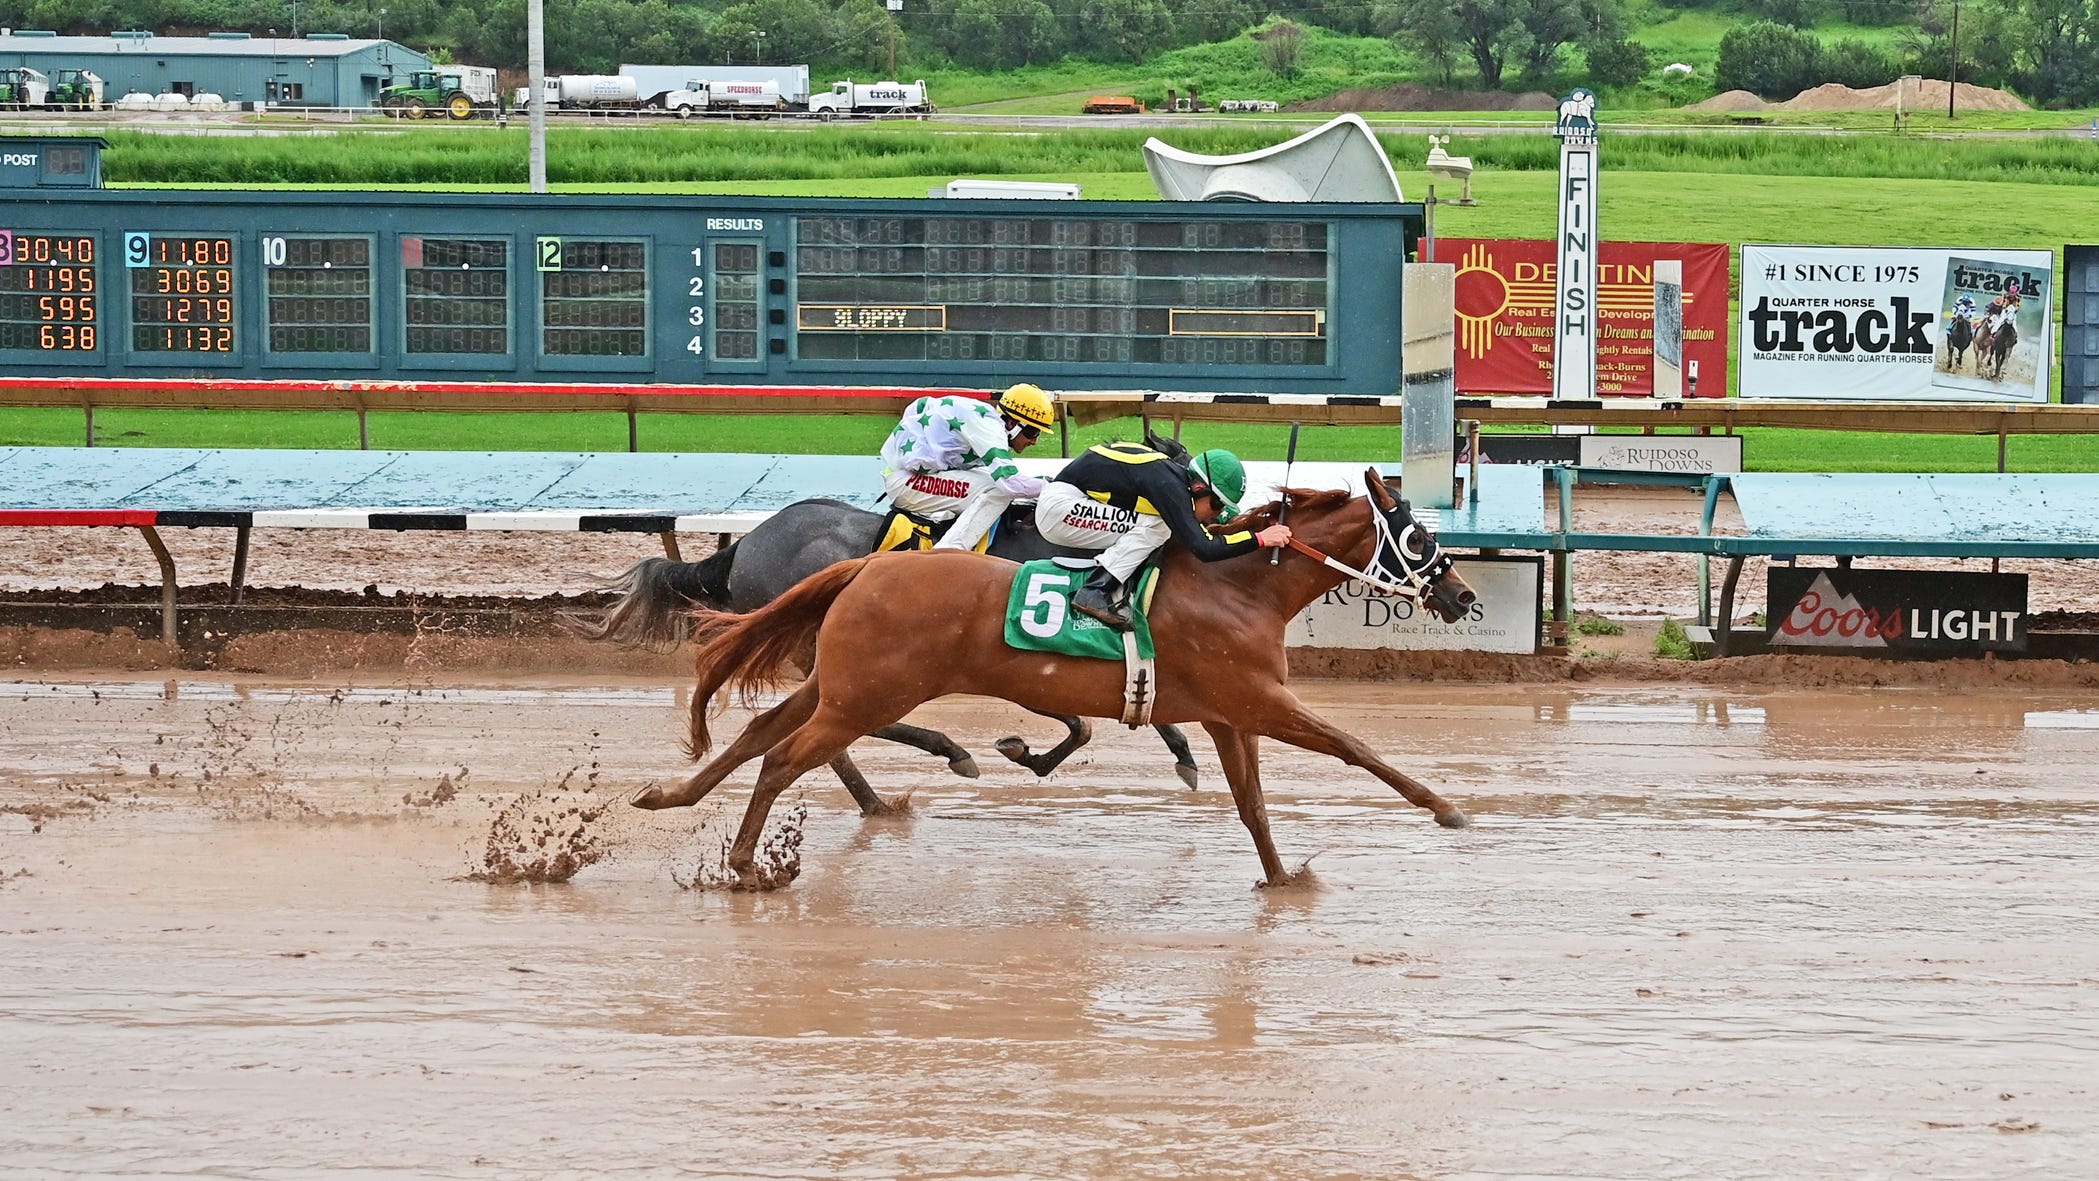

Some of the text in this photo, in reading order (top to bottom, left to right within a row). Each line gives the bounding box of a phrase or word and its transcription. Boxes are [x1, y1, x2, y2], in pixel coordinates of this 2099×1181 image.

[869, 89, 908, 100] track
[1552, 126, 1592, 136] RUIDOSO
[1564, 136, 1598, 145] DOWNS
[4, 154, 38, 166] POST
[706, 218, 764, 231] RESULTS
[128, 235, 148, 264] 9
[262, 237, 287, 266] 10
[537, 240, 561, 268] 12
[690, 248, 702, 267] 1
[1564, 177, 1587, 337] FINISH
[28, 268, 94, 292] 1195
[157, 269, 231, 294] 3069
[1515, 262, 1652, 284] DETIN
[1765, 263, 1920, 283] #1 SINCE 1975
[1953, 265, 2042, 297] track
[689, 277, 704, 296] 2
[39, 297, 94, 321] 595
[166, 298, 231, 323] 1279
[1508, 307, 1537, 317] Real
[1772, 297, 1876, 308] QUARTER HORSE
[688, 306, 704, 326] 3
[834, 309, 907, 328] SLOPPY
[1598, 309, 1654, 321] Develop
[1495, 321, 1555, 338] Our Business
[1604, 323, 1639, 340] Dreams
[1640, 328, 1653, 340] an
[1682, 326, 1715, 340] ination
[1749, 296, 1934, 355] track
[40, 326, 95, 350] 638
[166, 327, 231, 351] 1132
[687, 336, 703, 355] 4
[1532, 343, 1551, 353] Real
[1596, 345, 1653, 356] ightly Rentals
[1753, 352, 1934, 364] MAGAZINE FOR RUNNING QUARTER HORSES
[1597, 382, 1622, 391] -3000
[1611, 373, 1638, 382] Drive
[1627, 448, 1699, 464] RUIDOSO
[1649, 460, 1713, 471] DOWNS
[905, 472, 970, 498] PEEDHORSE
[1070, 503, 1140, 524] STALLION
[1019, 573, 1071, 638] 5
[1781, 591, 2021, 642] Coors LIGHT
[1391, 623, 1507, 637] Race Track & Casino
